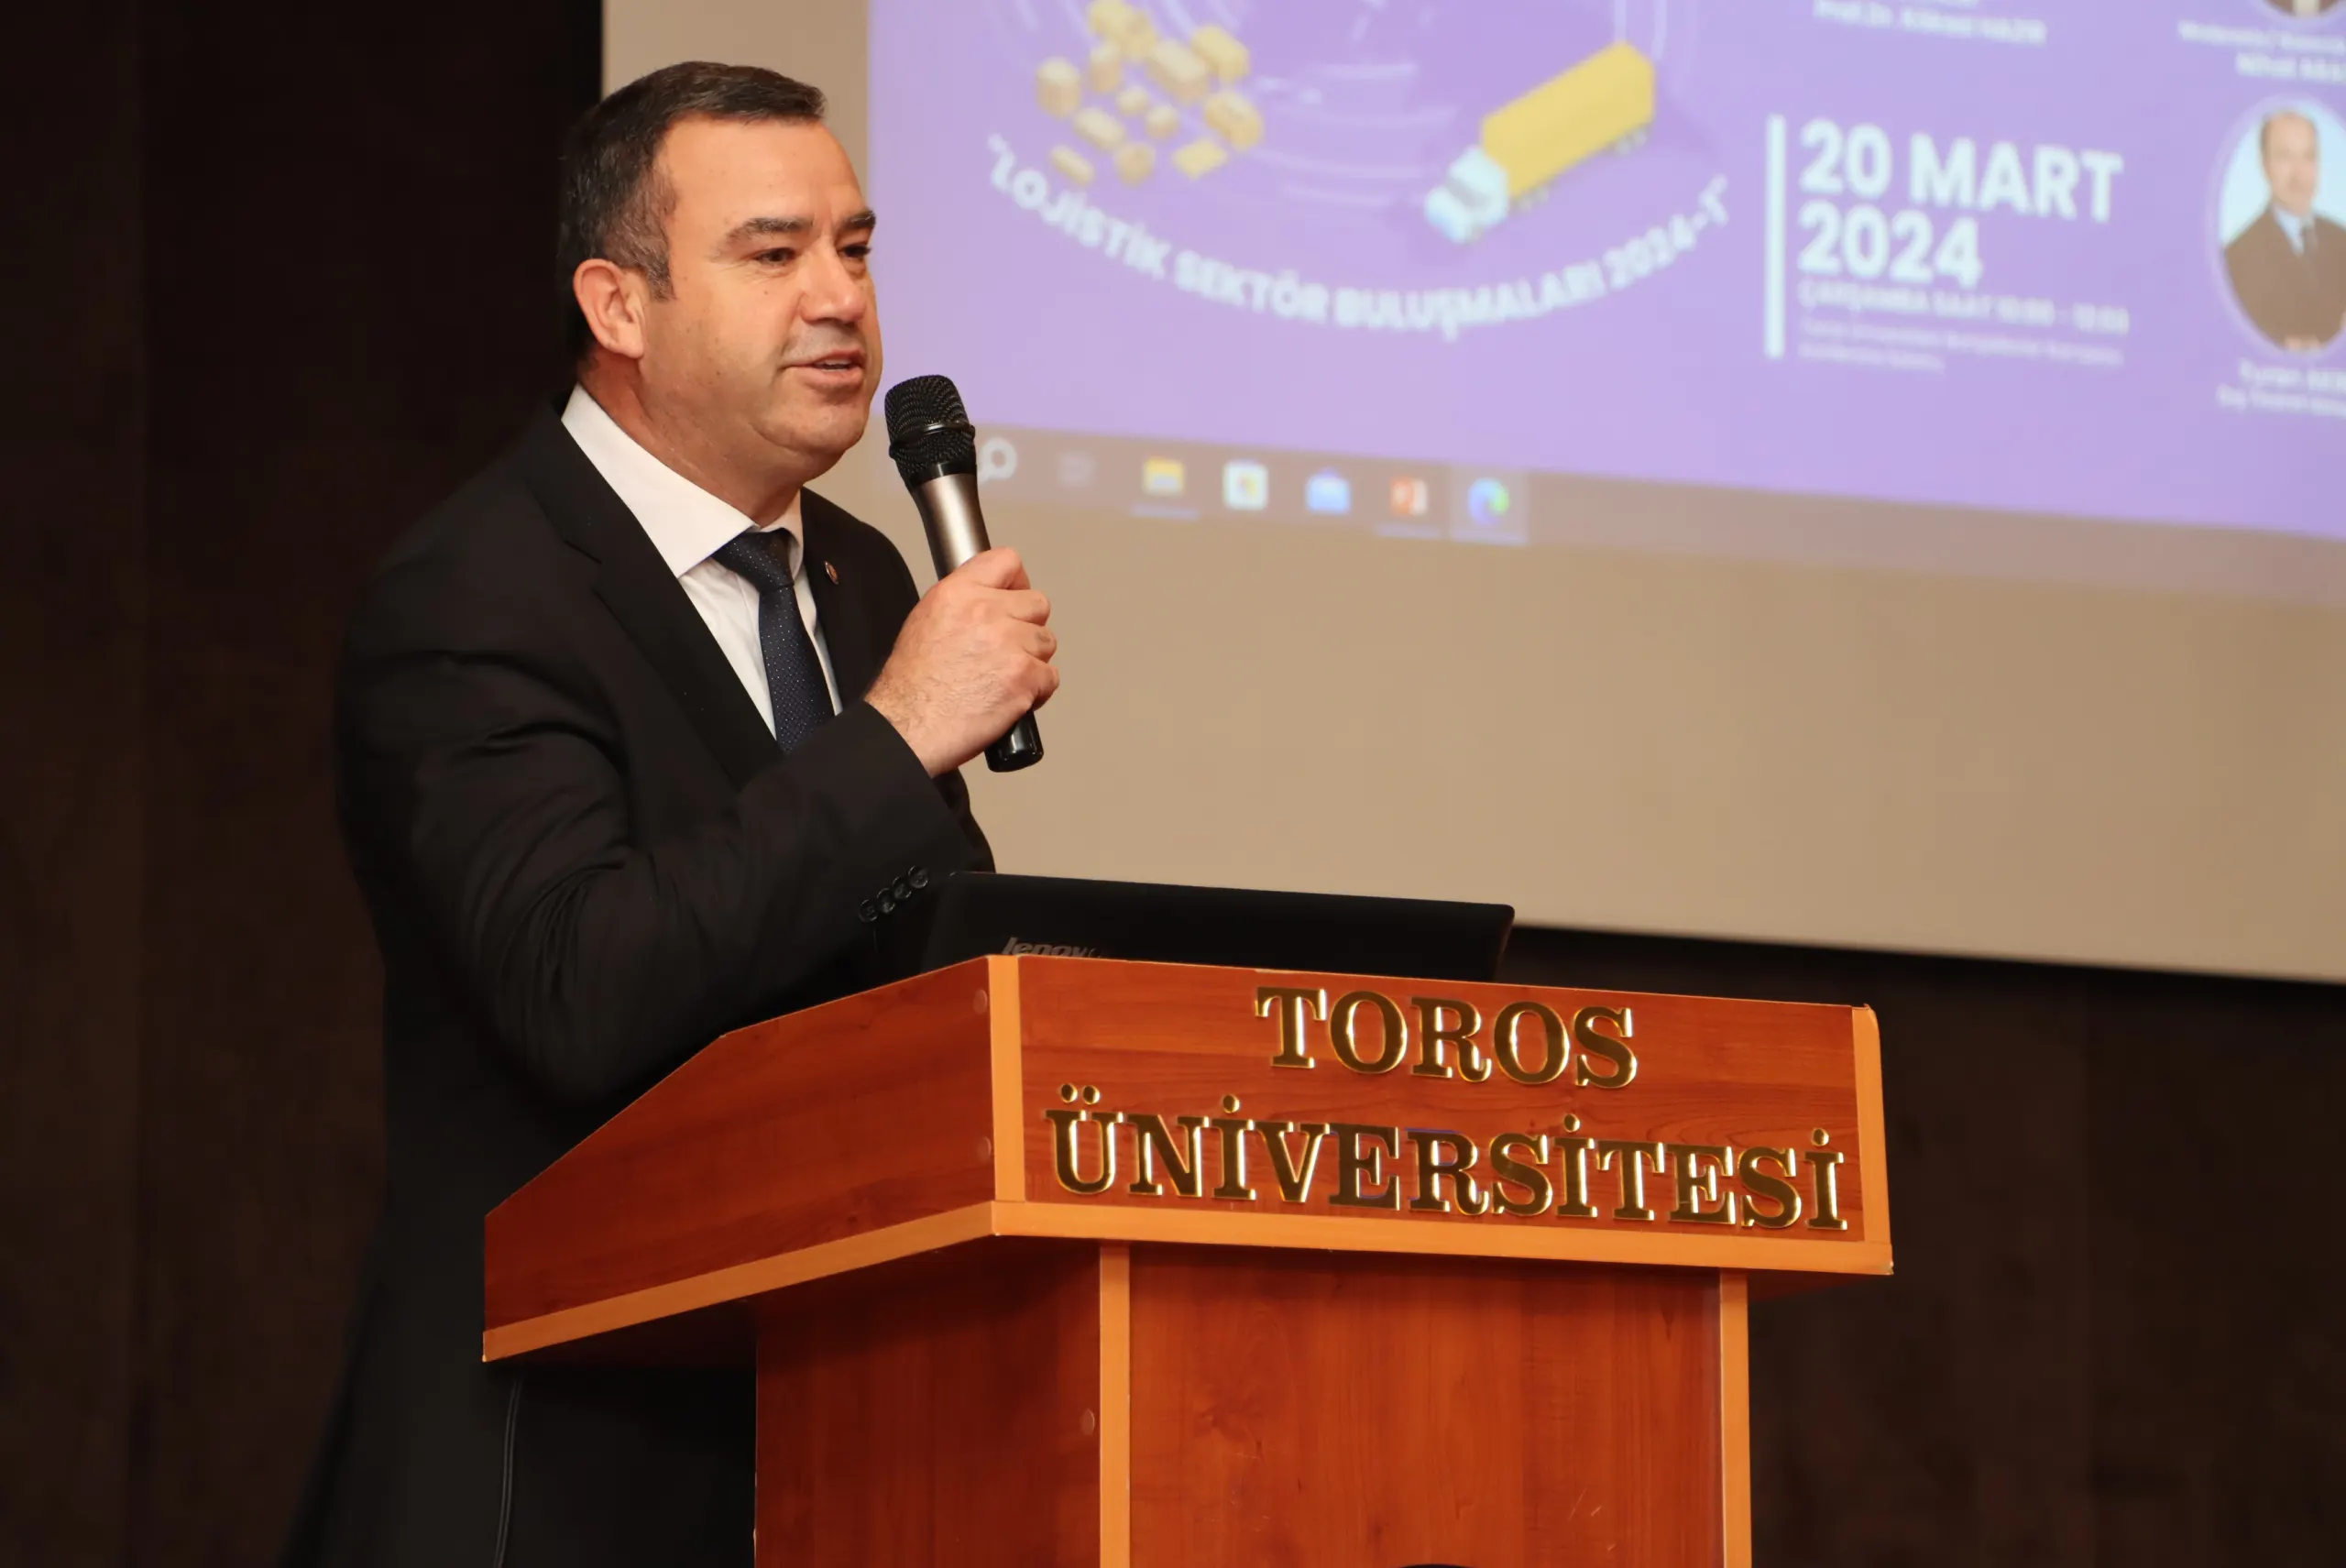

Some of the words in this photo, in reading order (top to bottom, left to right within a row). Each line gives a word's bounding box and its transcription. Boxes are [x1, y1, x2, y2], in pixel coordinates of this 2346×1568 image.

[1800, 118, 1892, 199] 20
[1910, 132, 2124, 224] MART
[1798, 200, 1984, 290] 2024
[1254, 985, 1638, 1089] TOROS
[1044, 1082, 1848, 1231] ÜNİVERSİTESİ
